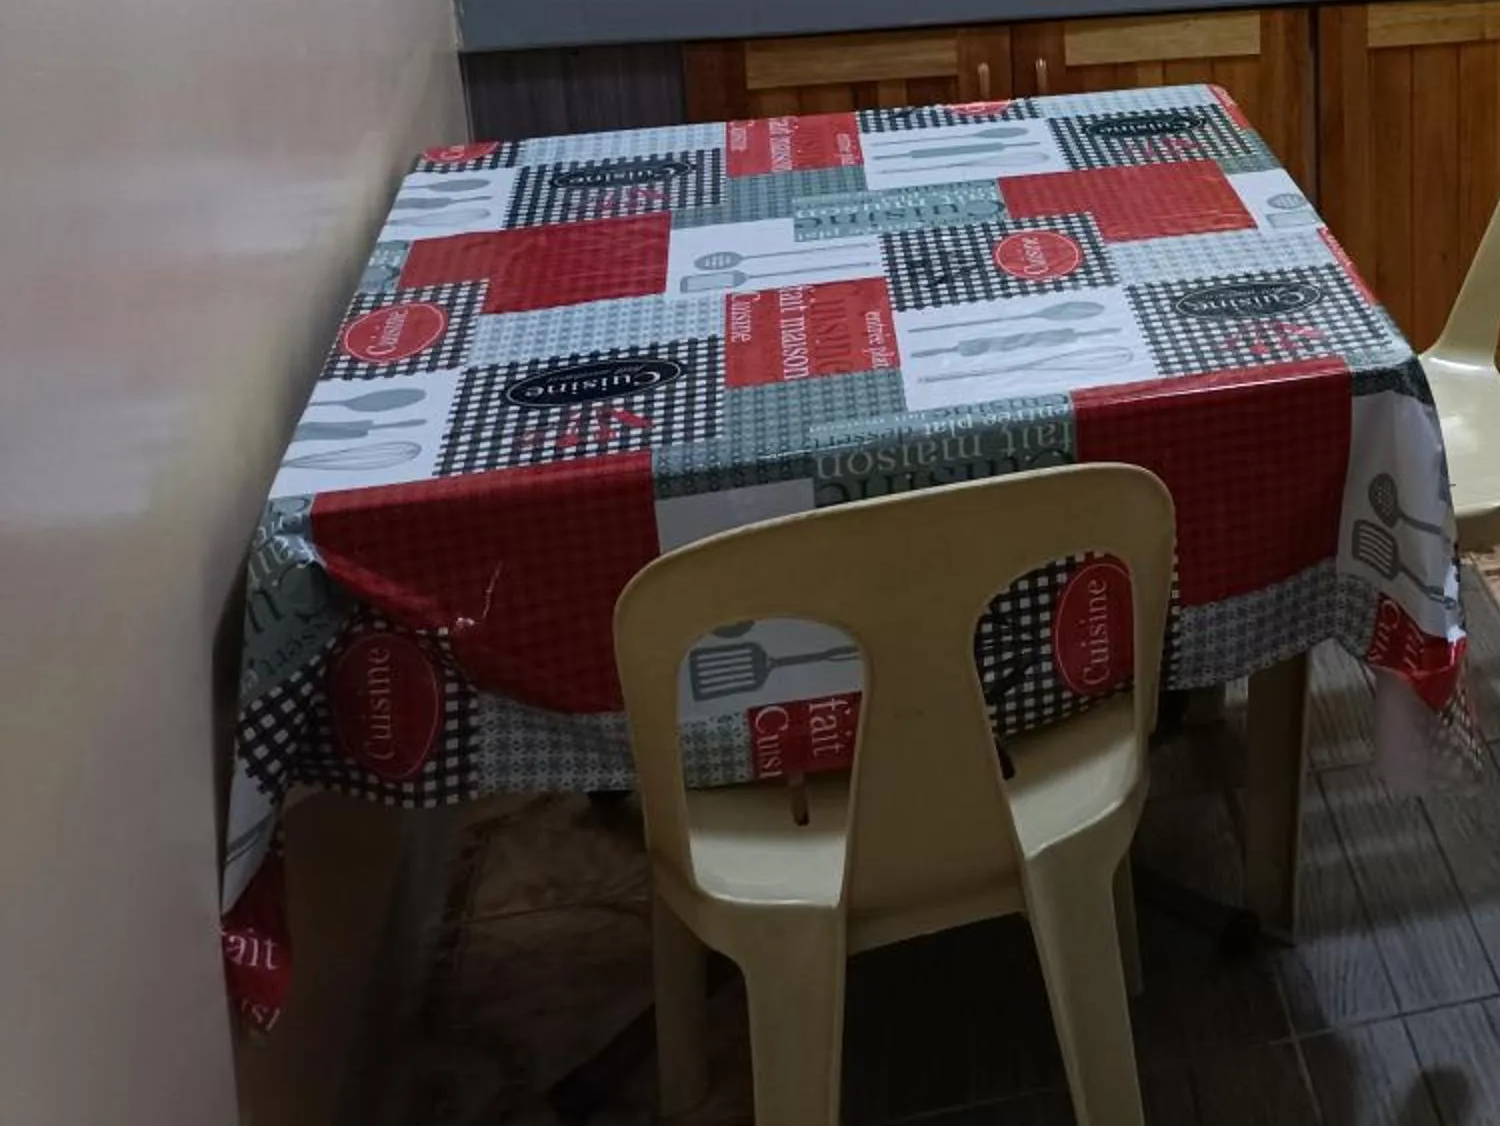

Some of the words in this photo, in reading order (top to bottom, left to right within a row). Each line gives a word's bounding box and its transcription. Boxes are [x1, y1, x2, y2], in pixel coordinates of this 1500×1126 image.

[730, 291, 761, 343] Cuisine
[1191, 290, 1305, 314] Cuisine
[780, 316, 819, 380] maison
[524, 370, 661, 400] Cuisine
[924, 413, 974, 438] plat
[996, 422, 1073, 463] fait
[816, 435, 982, 480] maison
[1078, 578, 1110, 686] Cuisine
[358, 648, 397, 760] Cuisine
[808, 697, 852, 757] fait
